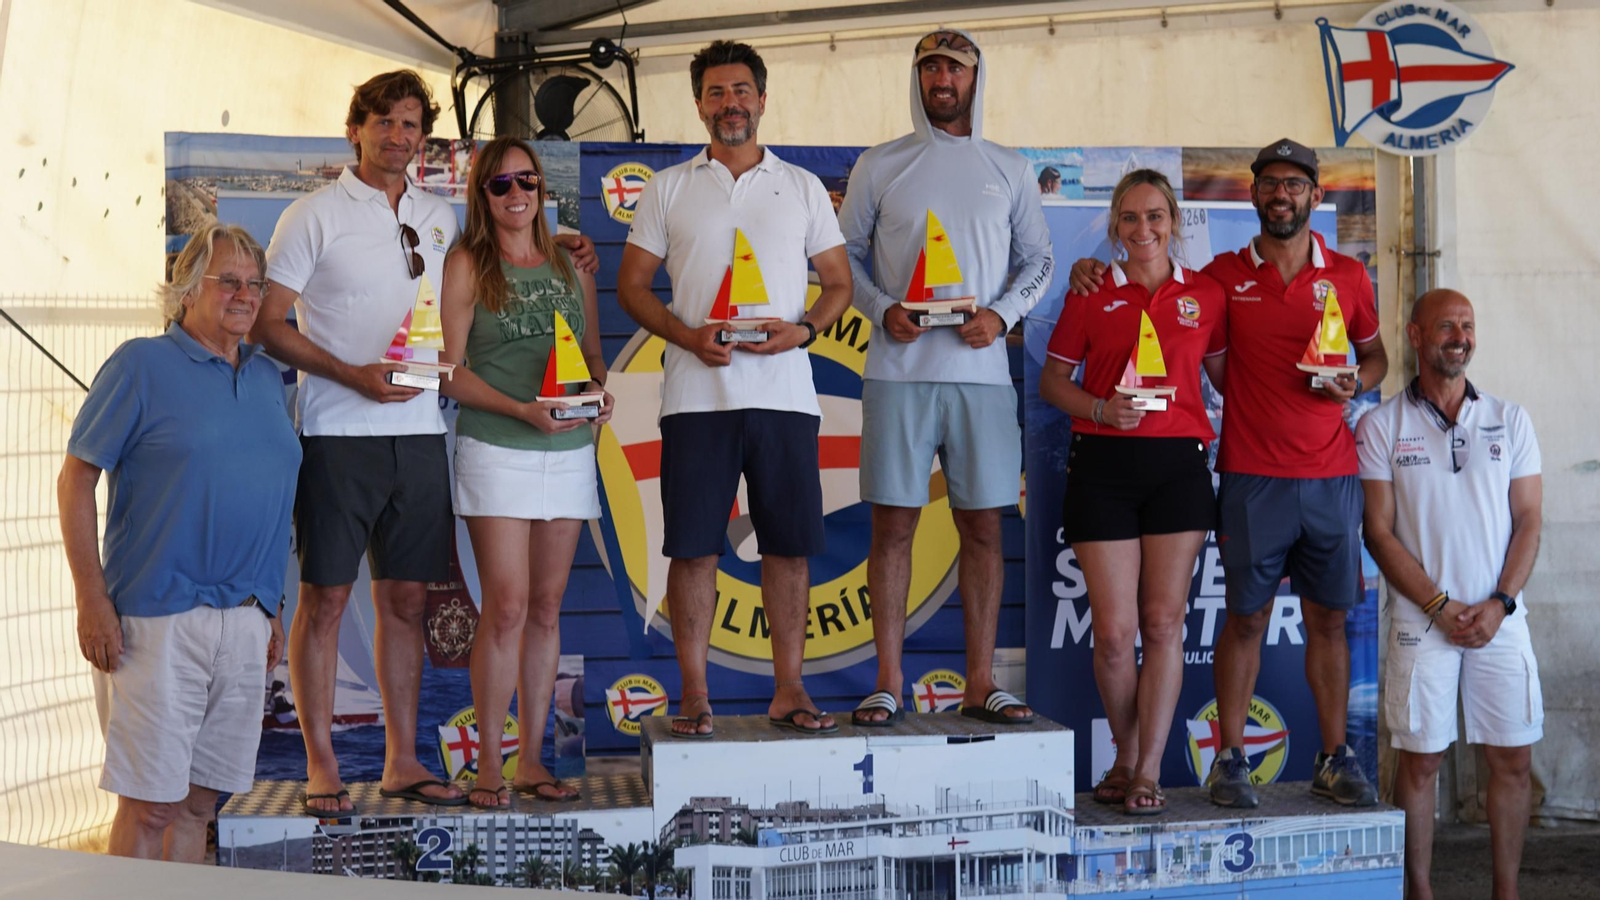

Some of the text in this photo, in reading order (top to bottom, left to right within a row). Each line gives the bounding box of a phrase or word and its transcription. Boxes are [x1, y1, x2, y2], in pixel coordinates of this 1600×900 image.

[1375, 4, 1416, 26] CLUB
[1435, 9, 1471, 39] MAR
[1383, 118, 1473, 150] ALMERIA
[612, 167, 628, 179] CLUB
[637, 168, 652, 180] MAR
[1183, 650, 1215, 665] ULIO
[616, 679, 633, 690] CLUB
[642, 679, 657, 692] MAR
[923, 674, 939, 685] CLUB
[947, 674, 962, 687] MAR
[1249, 702, 1271, 723] MAR
[853, 753, 874, 795] 1
[417, 826, 453, 870] 2
[779, 841, 854, 863] CLUB DE MAR
[1223, 832, 1255, 873] 3
